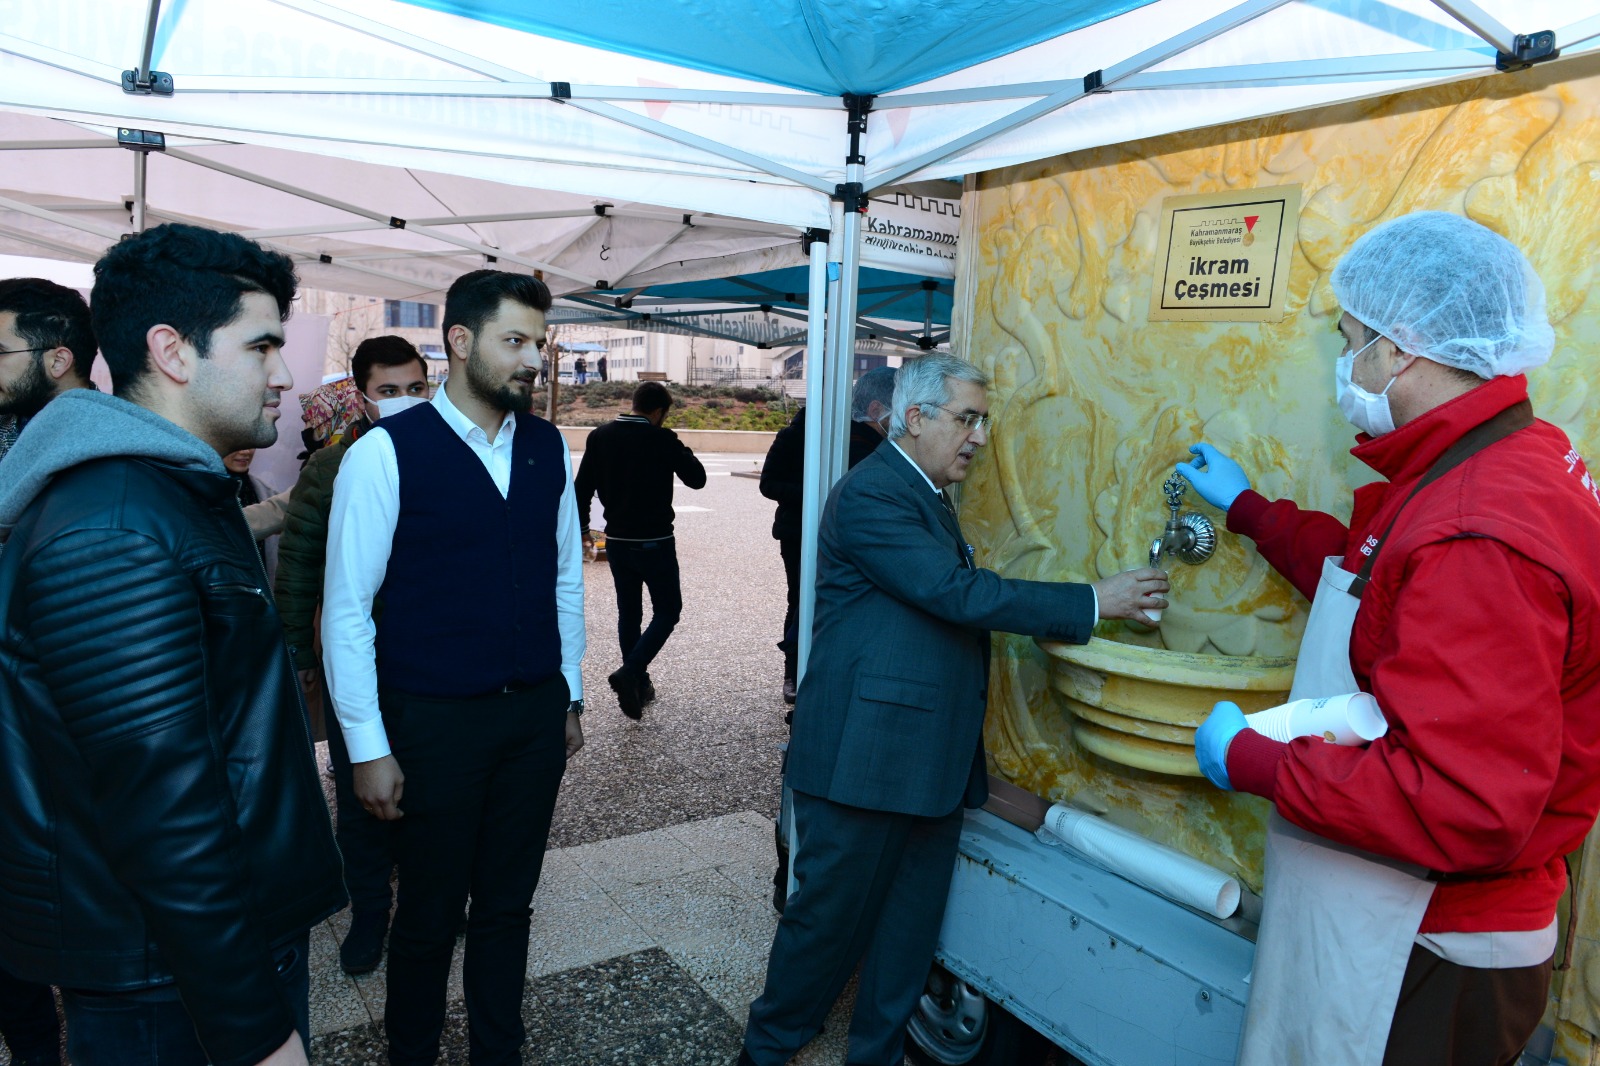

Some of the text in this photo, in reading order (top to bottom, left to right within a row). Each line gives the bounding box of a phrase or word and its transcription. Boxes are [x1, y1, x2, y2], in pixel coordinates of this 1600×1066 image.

[1190, 227, 1243, 238] Kahramanmaraş
[1189, 235, 1242, 247] Büyükşehir Belediyesi
[1189, 256, 1250, 276] ikram
[1174, 277, 1261, 301] Çeşmesi
